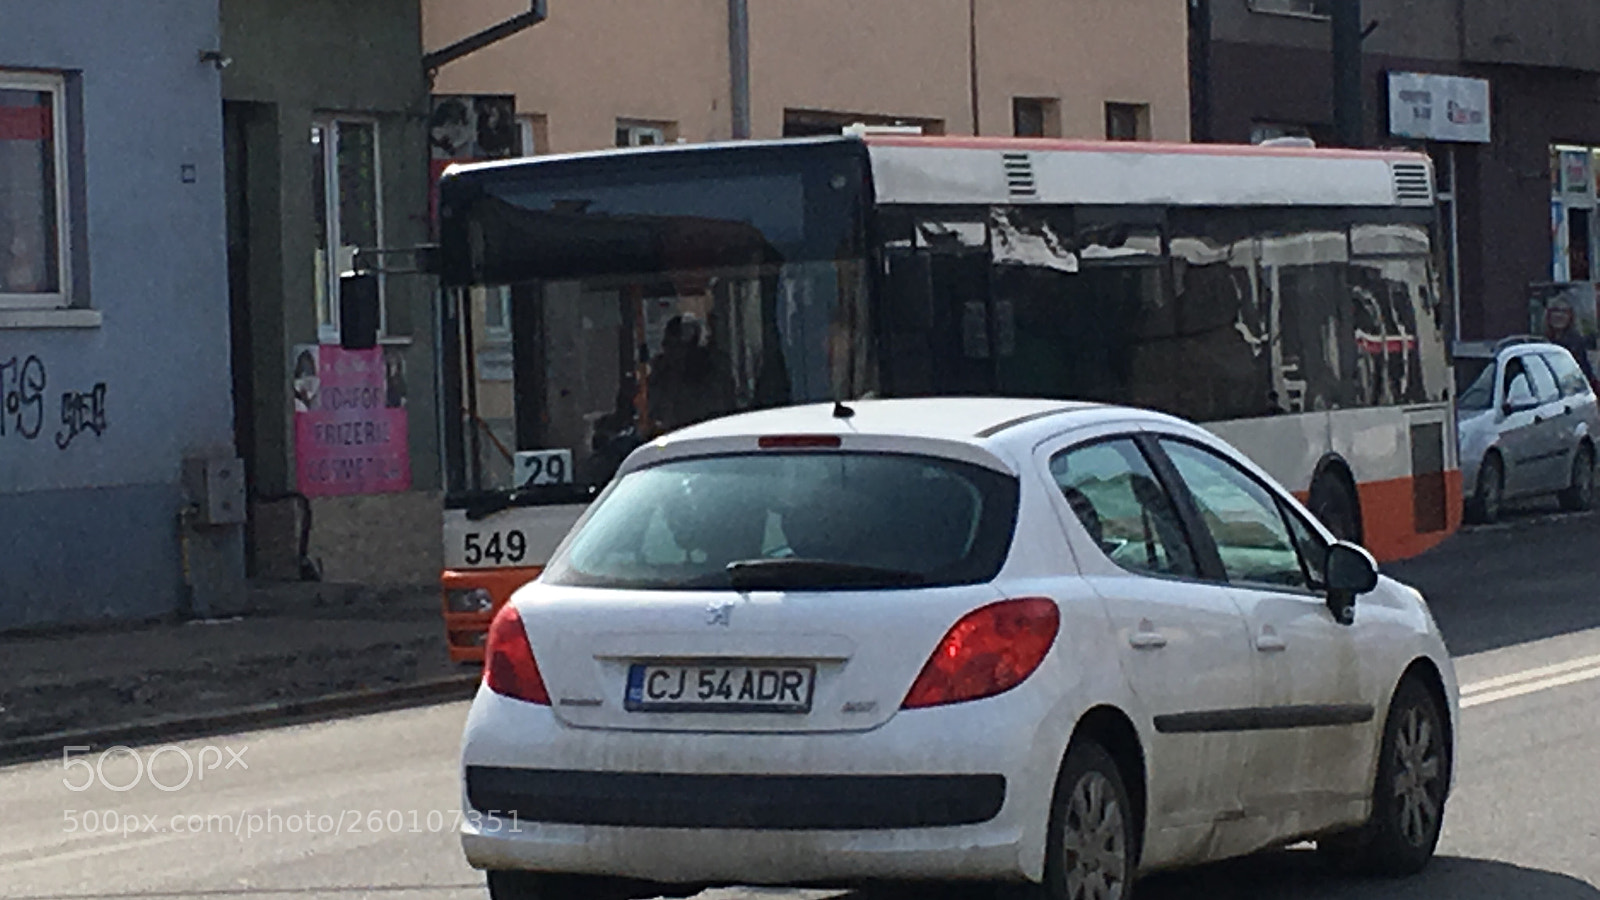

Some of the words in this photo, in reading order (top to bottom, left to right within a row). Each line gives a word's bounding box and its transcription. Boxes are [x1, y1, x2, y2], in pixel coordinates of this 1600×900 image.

[524, 455, 565, 489] 29
[464, 529, 527, 565] 549
[647, 669, 687, 700] CJ
